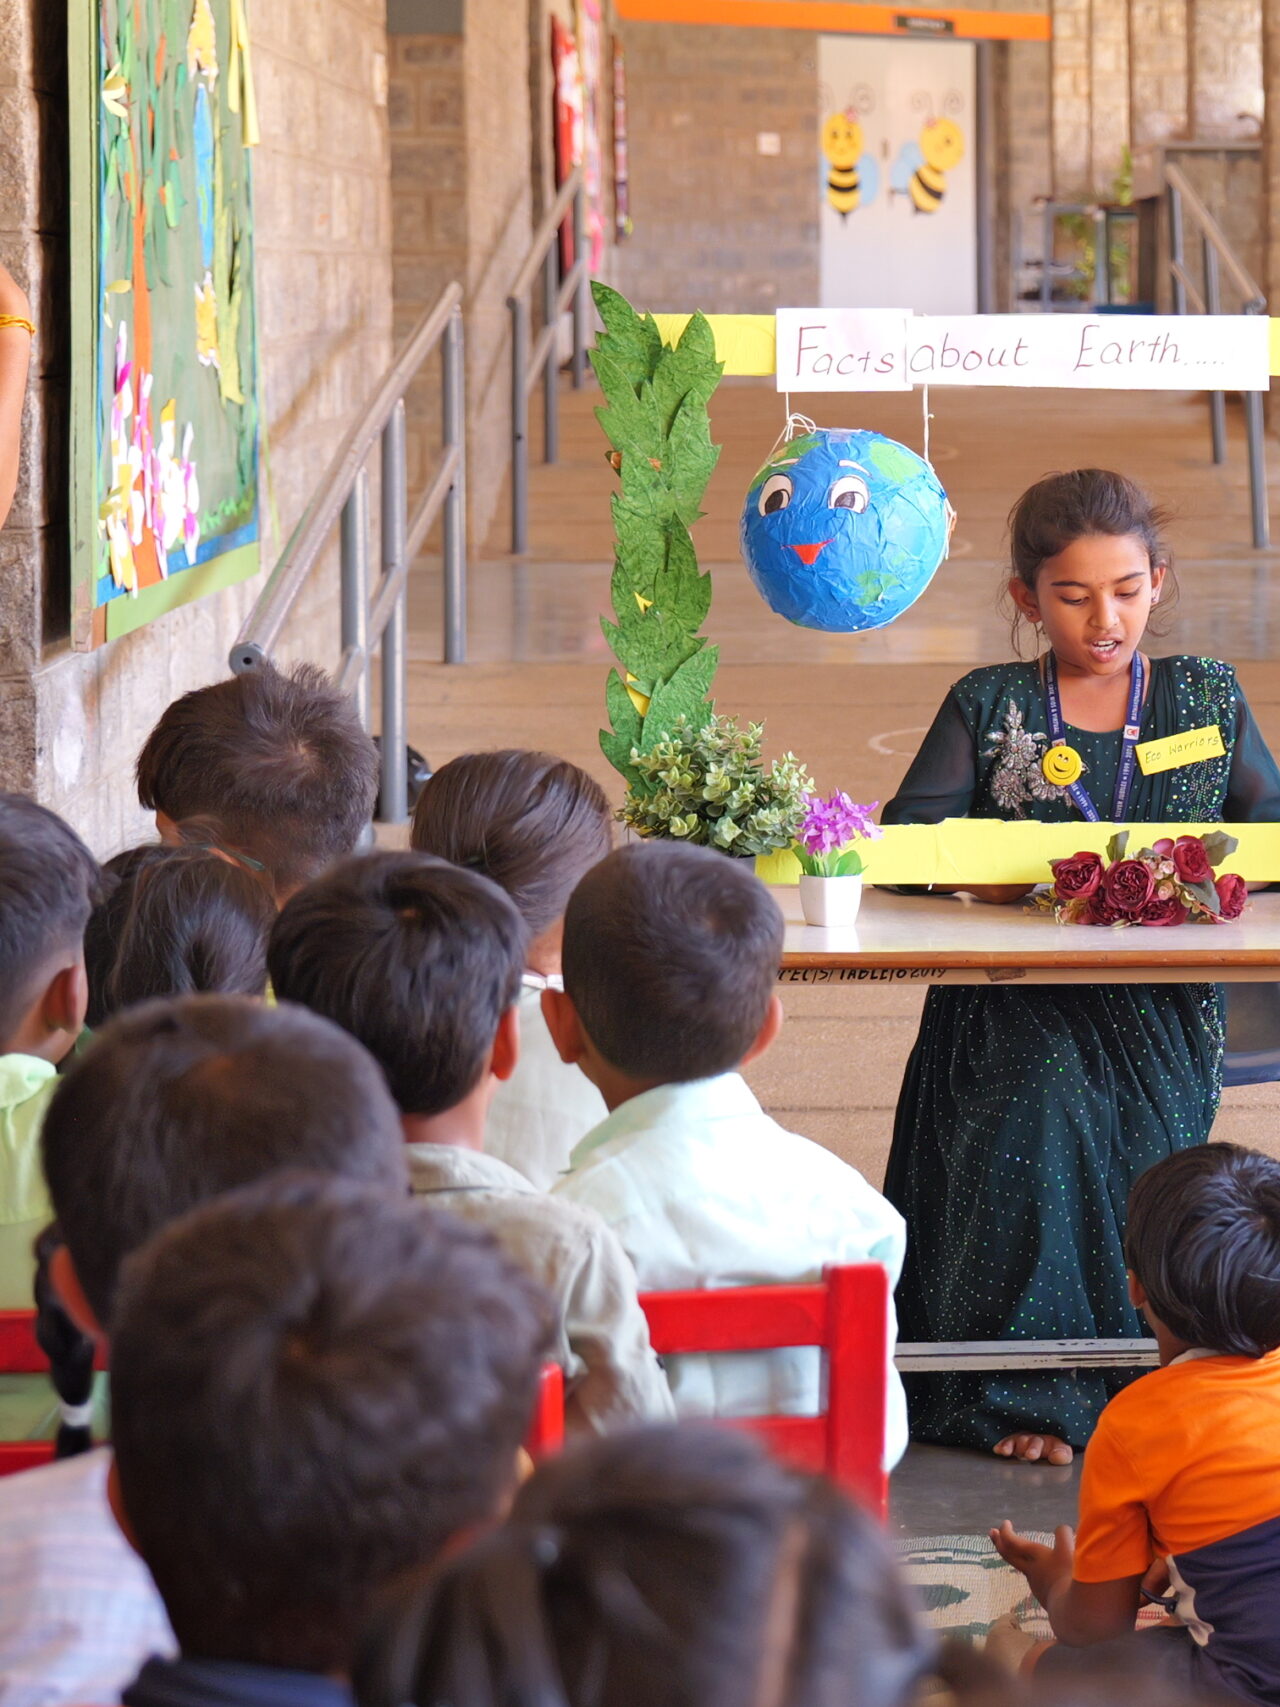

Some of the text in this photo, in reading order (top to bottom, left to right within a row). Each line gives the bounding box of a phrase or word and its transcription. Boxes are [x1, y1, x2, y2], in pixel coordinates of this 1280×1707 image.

[795, 325, 895, 376] Facts
[909, 332, 1029, 373] about
[1145, 736, 1219, 764] Eco Warriors
